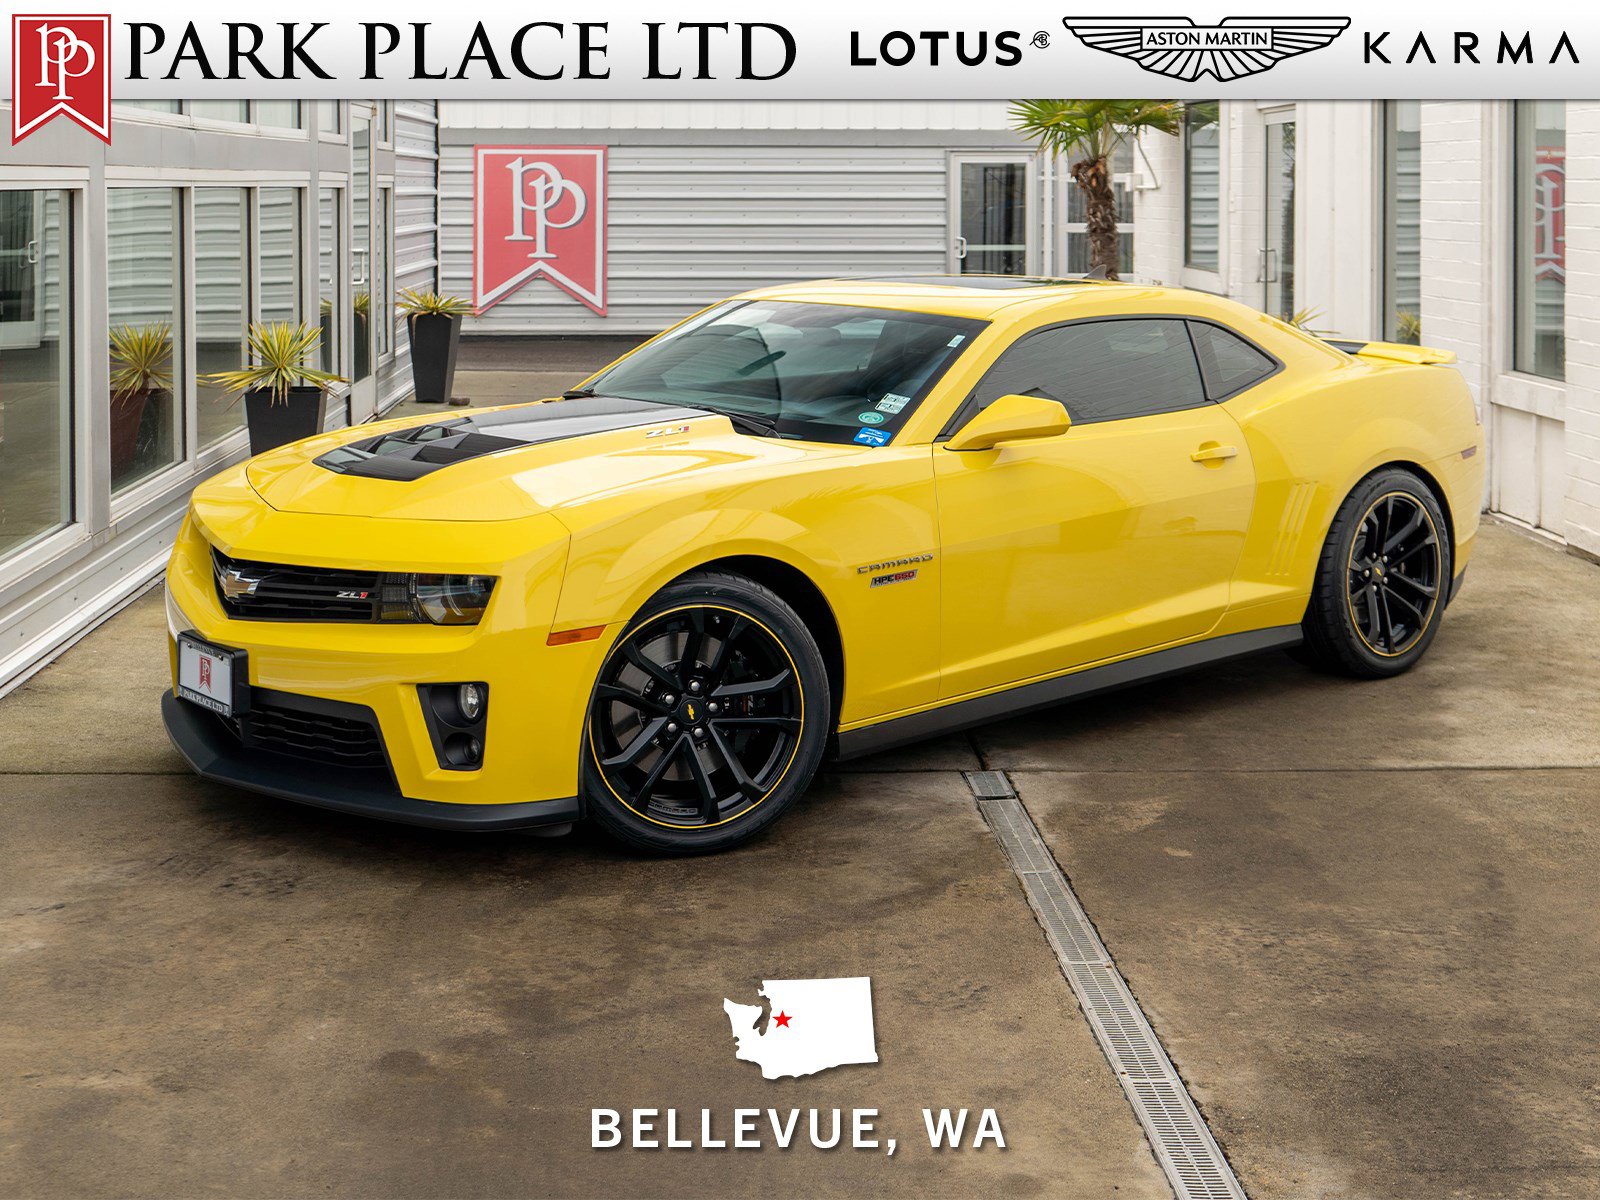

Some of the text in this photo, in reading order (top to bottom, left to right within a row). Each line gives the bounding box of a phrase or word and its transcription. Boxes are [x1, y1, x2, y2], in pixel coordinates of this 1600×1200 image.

[857, 553, 934, 574] CAMARO
[336, 590, 368, 599] ZL1
[196, 696, 212, 709] PLACE
[212, 702, 224, 713] LTD
